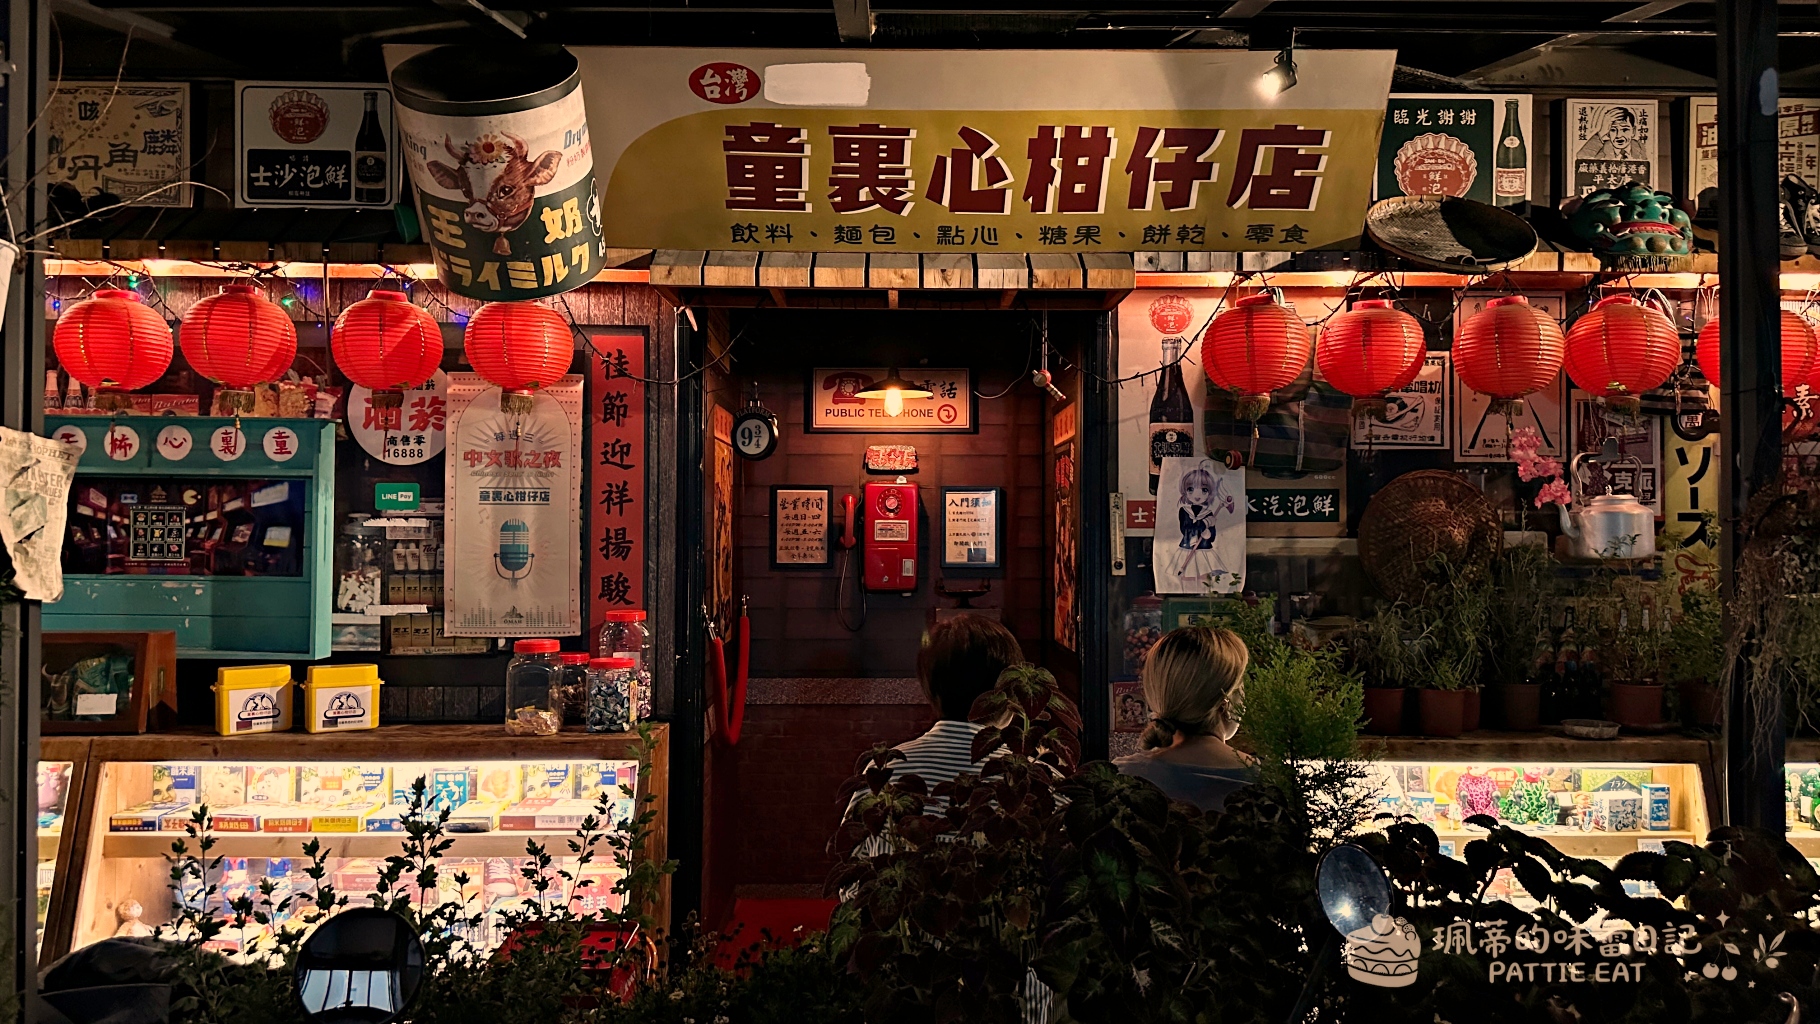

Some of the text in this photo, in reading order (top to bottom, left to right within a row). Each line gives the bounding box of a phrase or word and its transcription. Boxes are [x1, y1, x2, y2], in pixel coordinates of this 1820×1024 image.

[699, 68, 748, 101] 台灣
[723, 122, 1332, 216] 童裏心柑仔店
[736, 406, 771, 418] PLATFORM
[825, 408, 865, 418] PUBLIC
[386, 449, 424, 458] 16888
[463, 449, 562, 468] 中文歌之夜
[480, 490, 550, 502] 童裏心柑仔店
[949, 497, 992, 508] 入門須知
